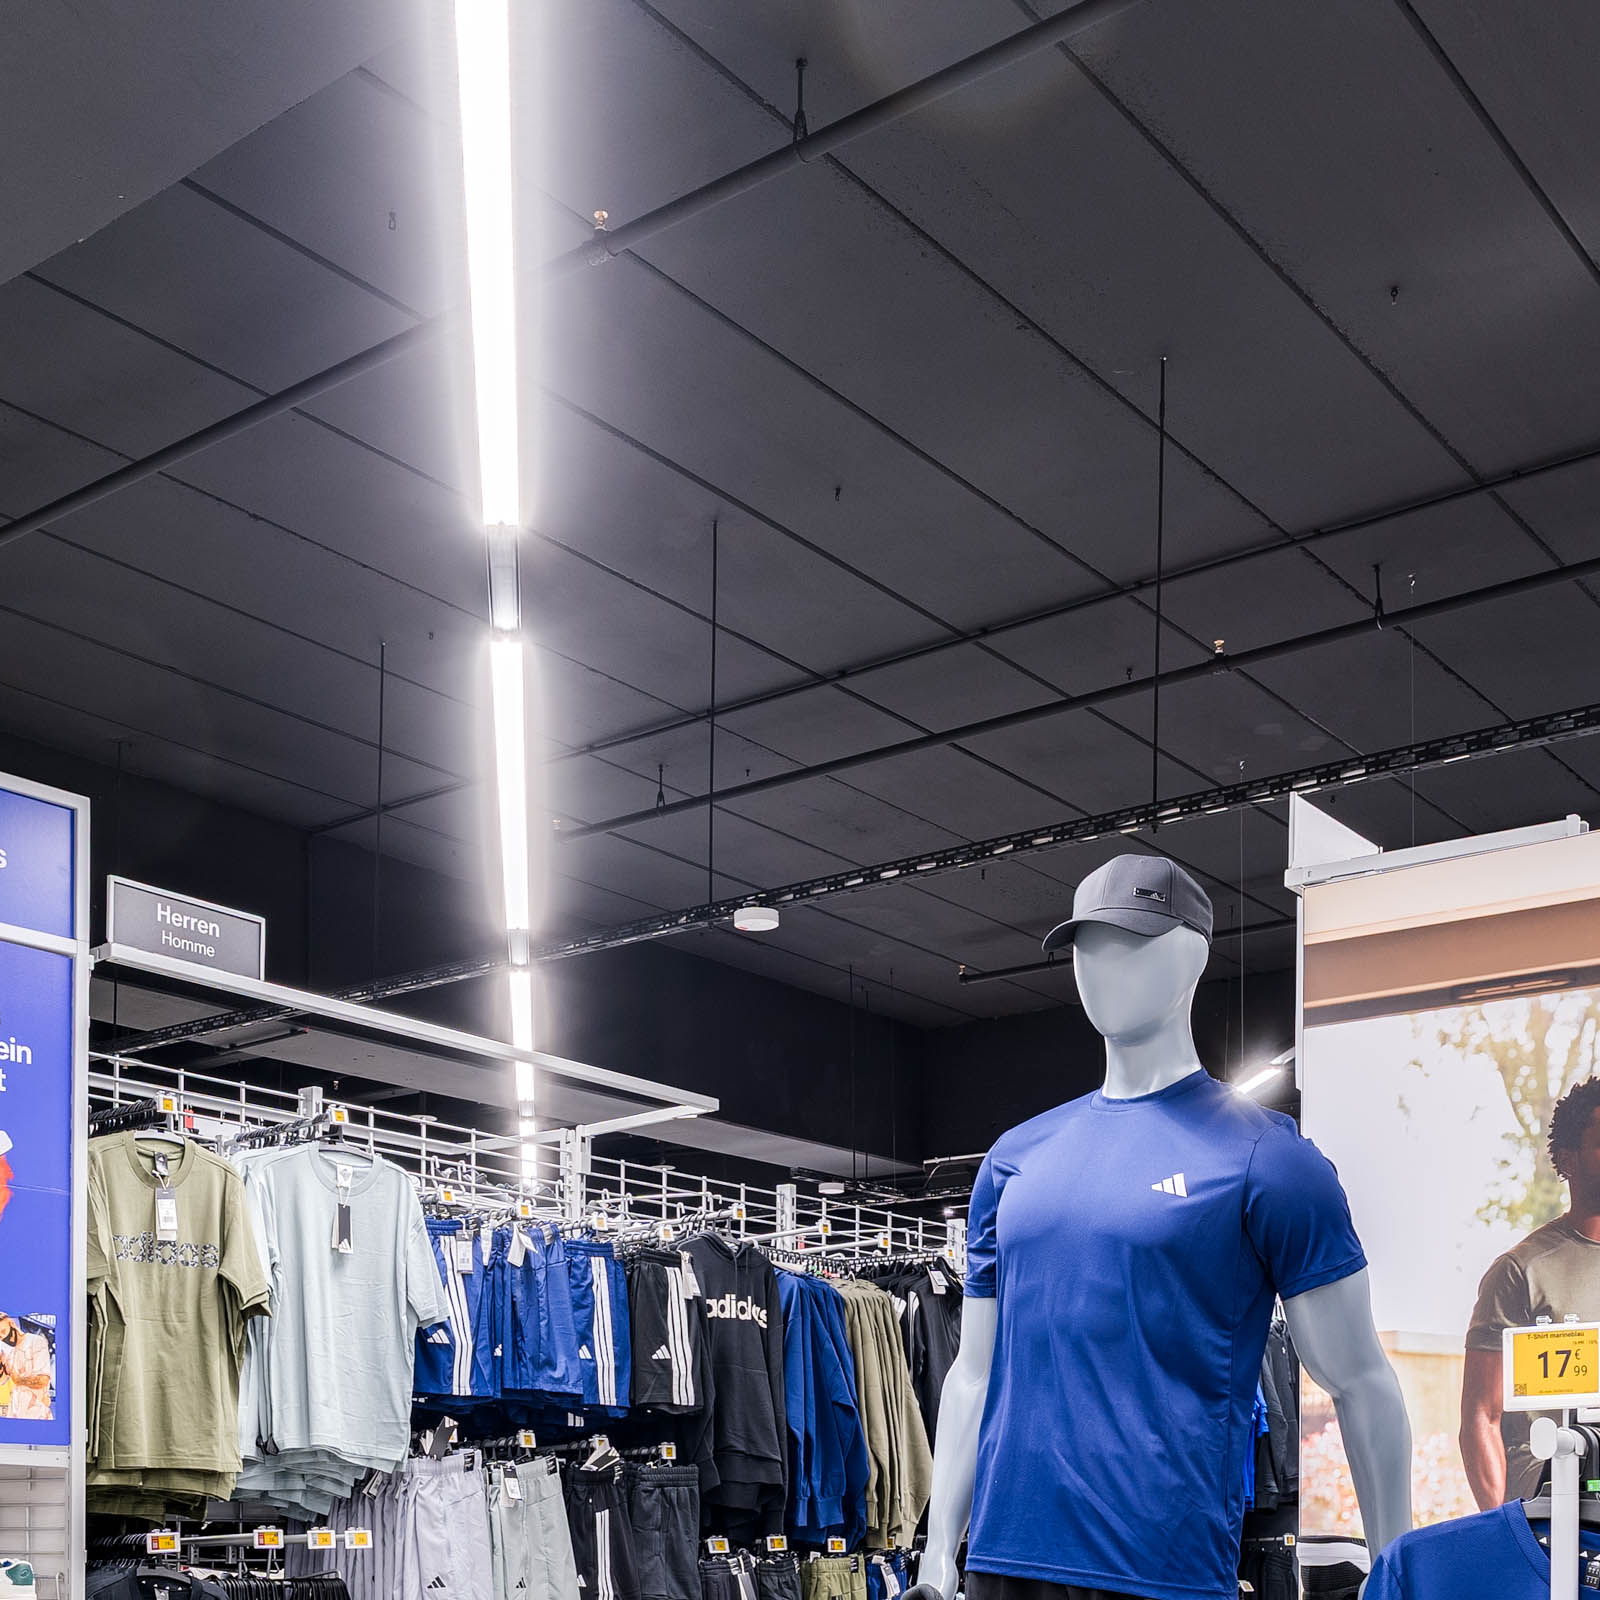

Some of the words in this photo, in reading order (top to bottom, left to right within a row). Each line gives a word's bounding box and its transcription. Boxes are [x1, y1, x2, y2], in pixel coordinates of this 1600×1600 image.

[157, 902, 220, 938] Herren
[161, 930, 215, 957] Homme
[705, 1293, 768, 1329] adidas
[1527, 1333, 1549, 1341] T-Shirt
[1537, 1349, 1572, 1379] 17
[1574, 1348, 1581, 1361] €
[1573, 1364, 1588, 1377] 99
